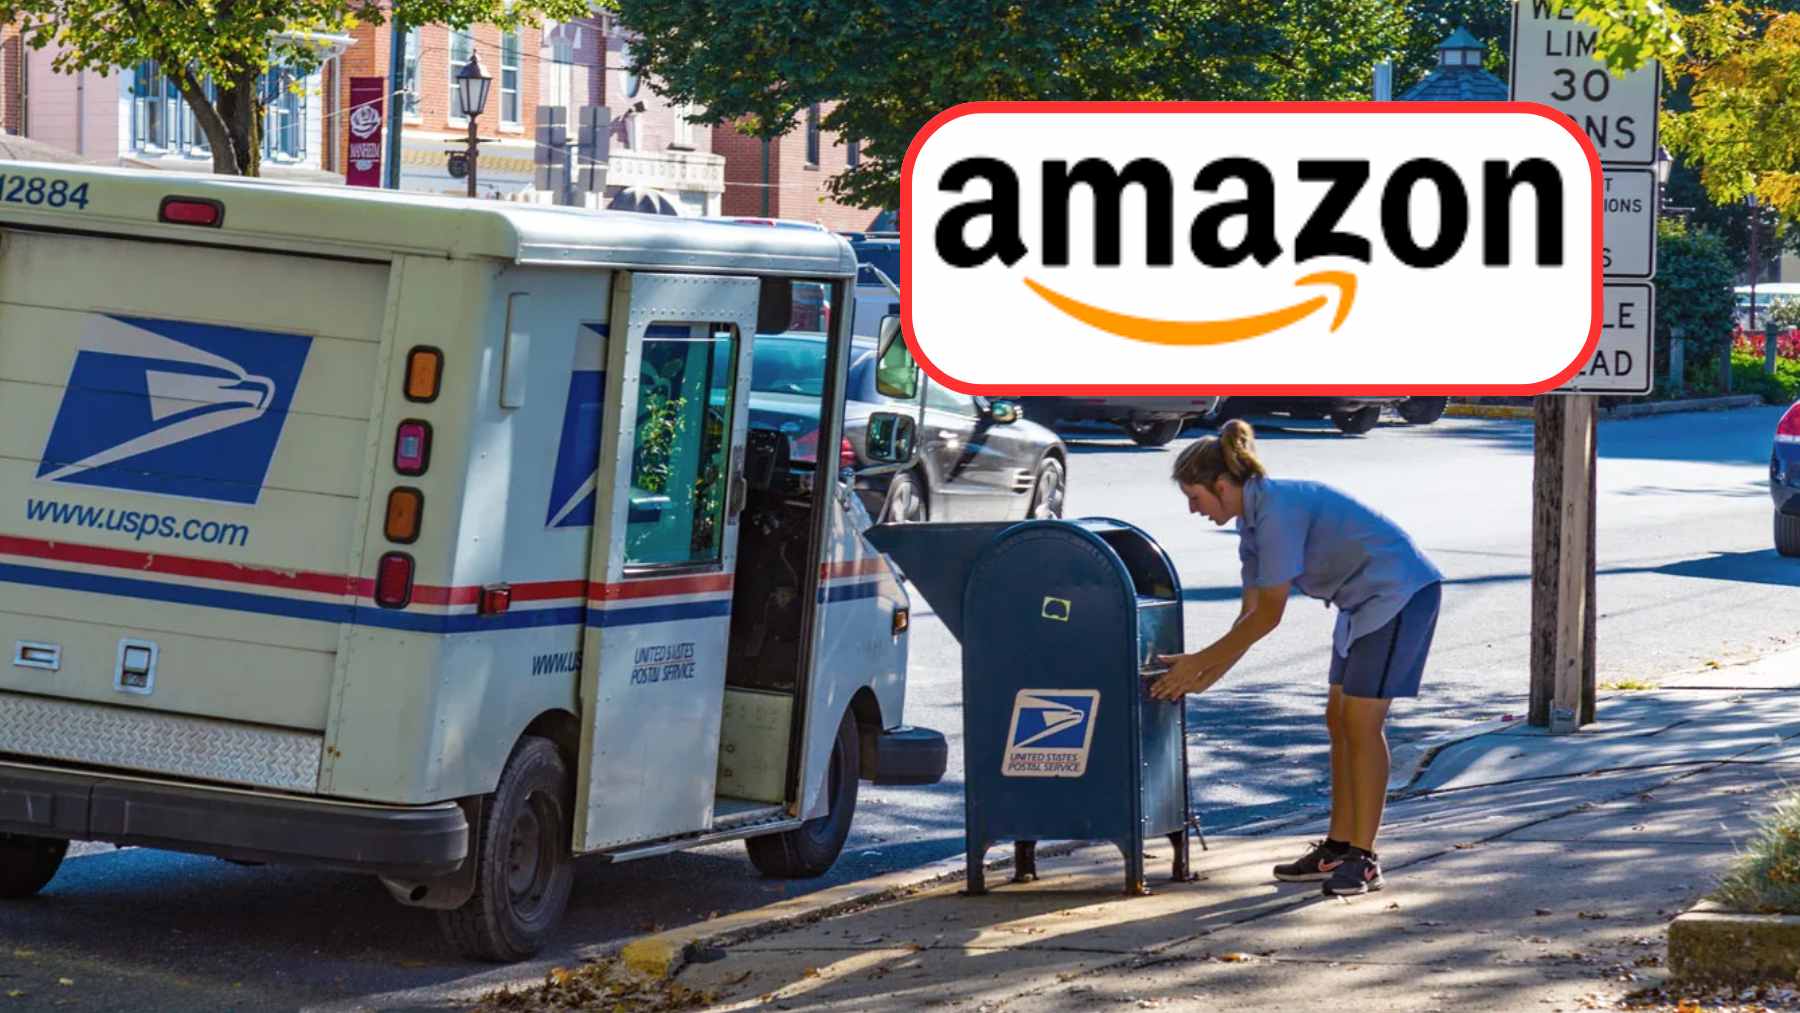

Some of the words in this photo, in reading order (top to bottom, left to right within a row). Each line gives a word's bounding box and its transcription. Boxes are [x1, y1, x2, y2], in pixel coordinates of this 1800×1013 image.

[1546, 30, 1598, 57] LIM
[1550, 68, 1610, 102] 30
[1566, 115, 1636, 149] NS
[1603, 198, 1642, 213] IONS
[26, 498, 249, 546] www.usps.com
[634, 645, 666, 664] UNITED
[1008, 763, 1041, 771] POSTAL
[1043, 763, 1078, 772] SERVICE
[1009, 753, 1044, 761] UNITED
[1045, 753, 1078, 761] STATES
